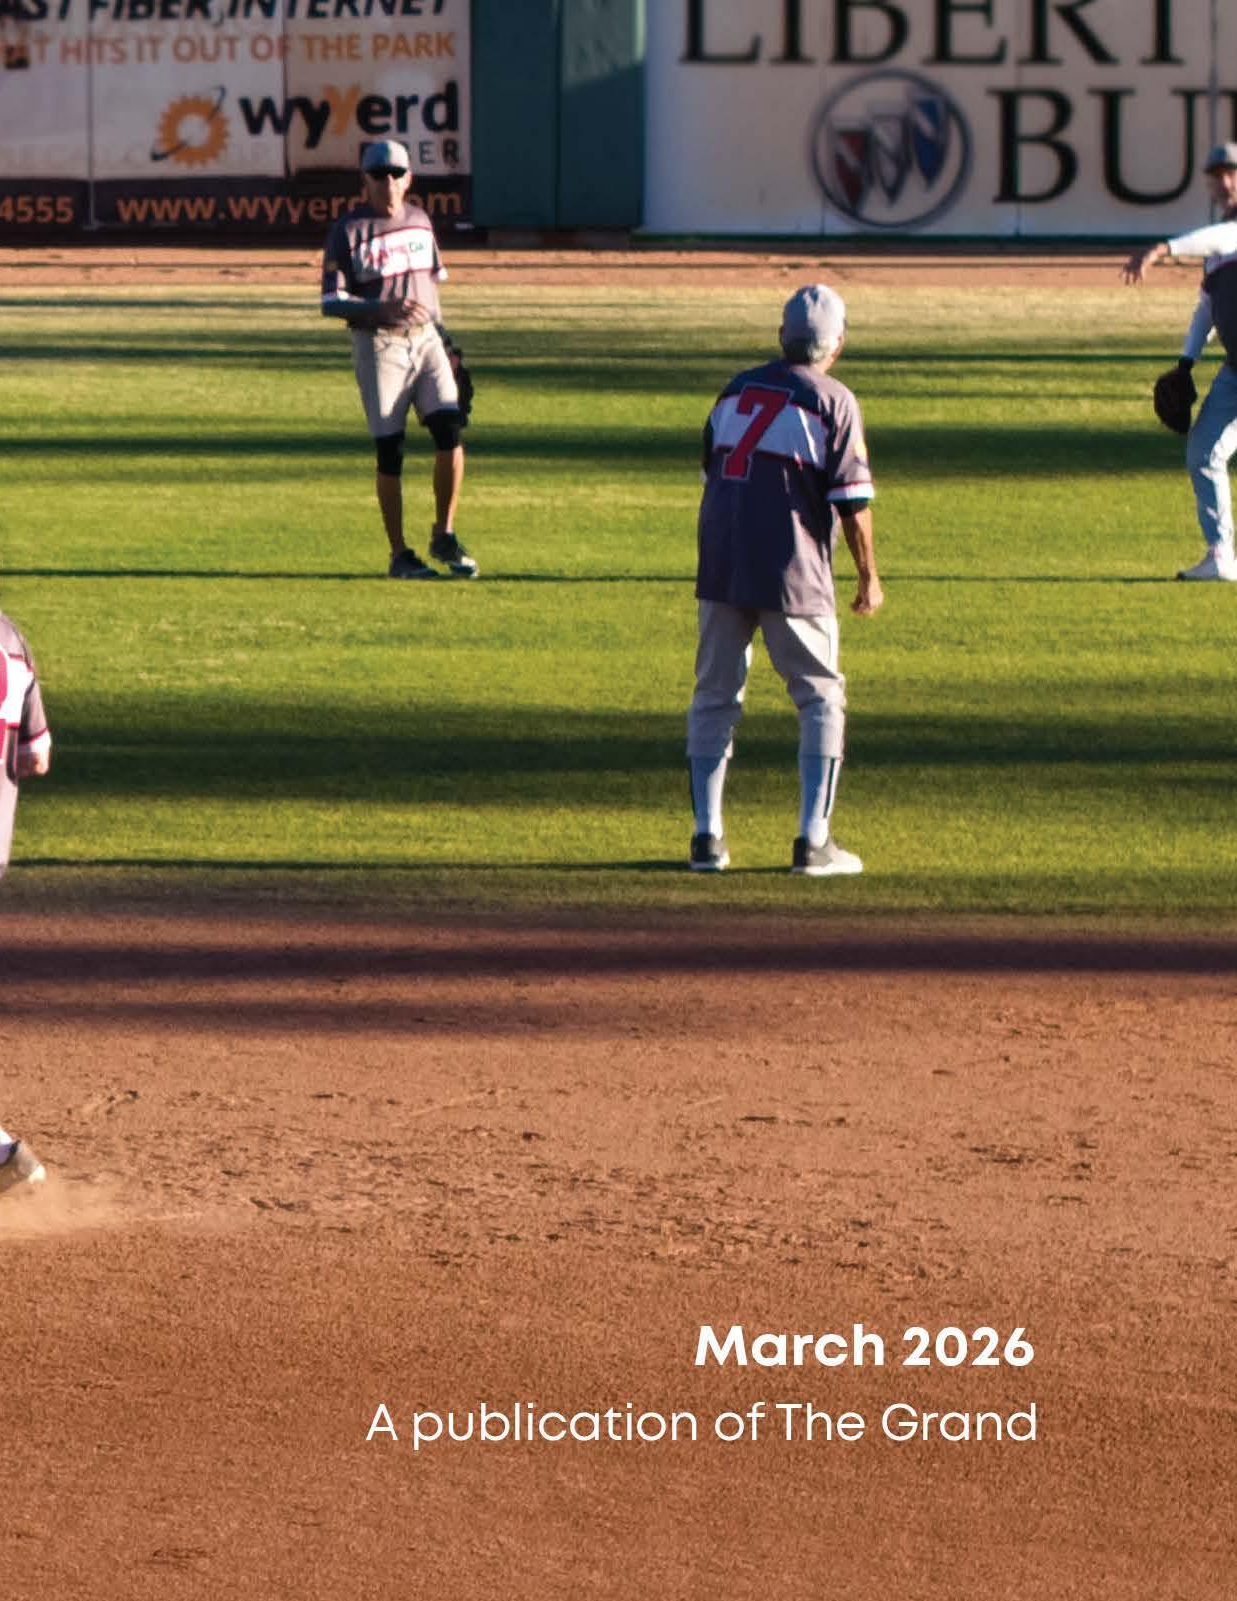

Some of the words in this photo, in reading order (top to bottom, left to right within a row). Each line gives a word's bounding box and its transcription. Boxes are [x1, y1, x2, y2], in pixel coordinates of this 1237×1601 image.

[59, 35, 126, 65] HITS
[136, 35, 165, 64] IT
[172, 35, 238, 64] OUT
[250, 34, 289, 62] OF
[297, 33, 363, 62] THE
[371, 32, 457, 61] PARK
[722, 381, 795, 481] 7
